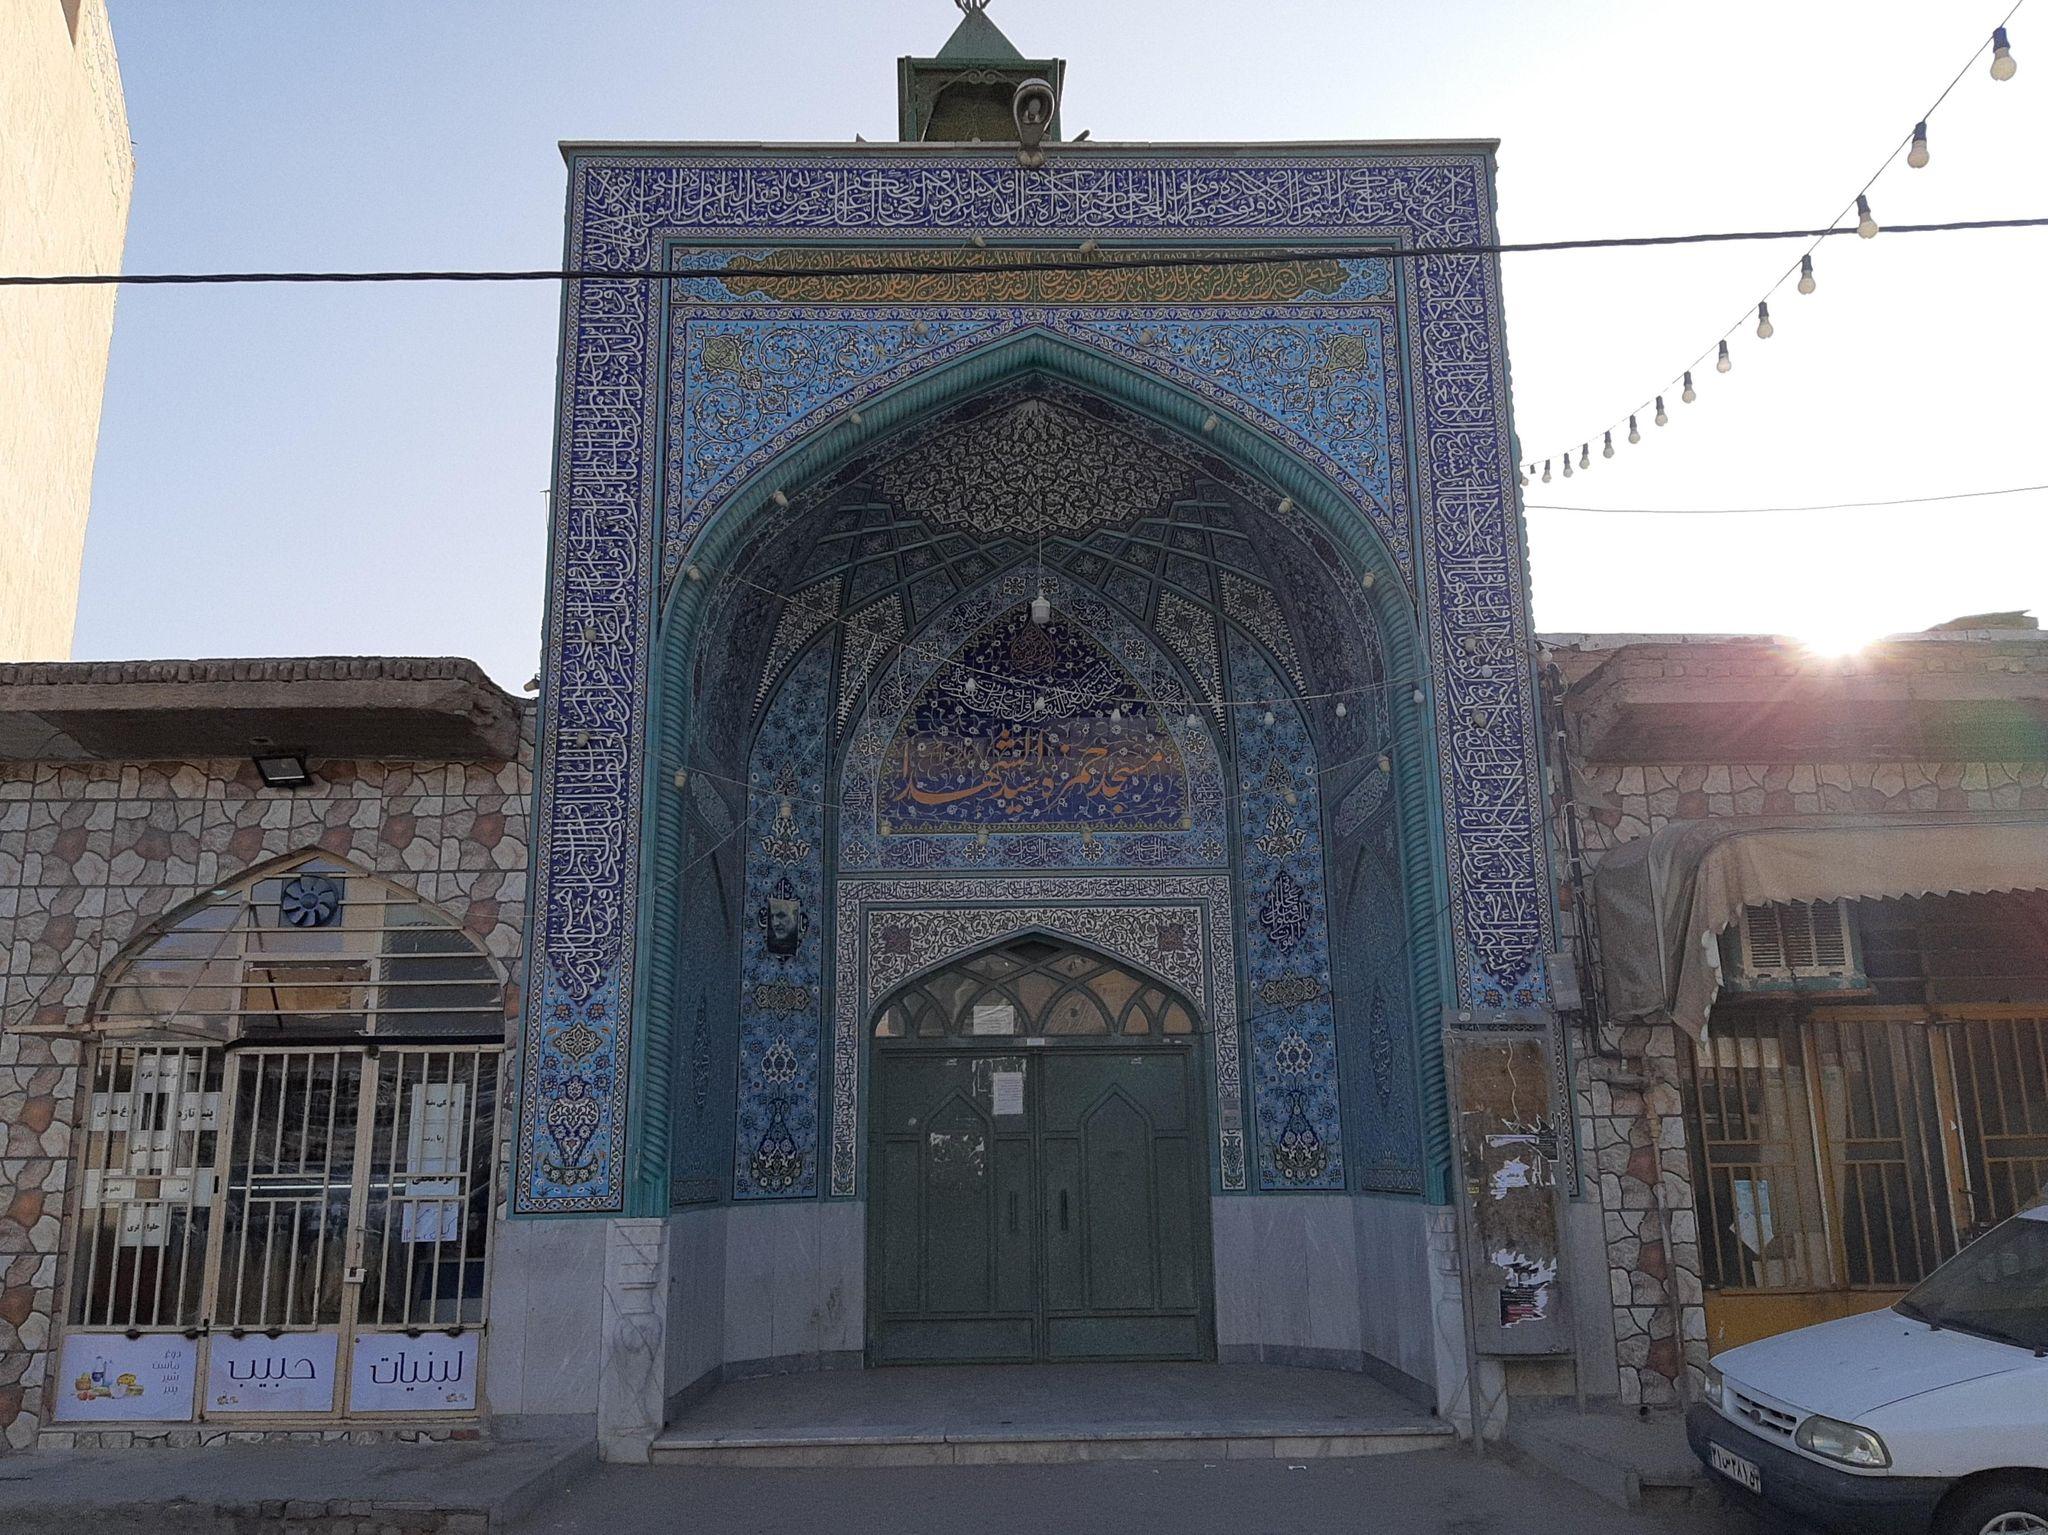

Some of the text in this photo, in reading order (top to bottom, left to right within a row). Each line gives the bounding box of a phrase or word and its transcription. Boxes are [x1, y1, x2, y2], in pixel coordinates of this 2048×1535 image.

[1088, 750, 1165, 813] مسجد
[228, 1352, 317, 1389] حبیب
[369, 1349, 464, 1392] لبنیات
